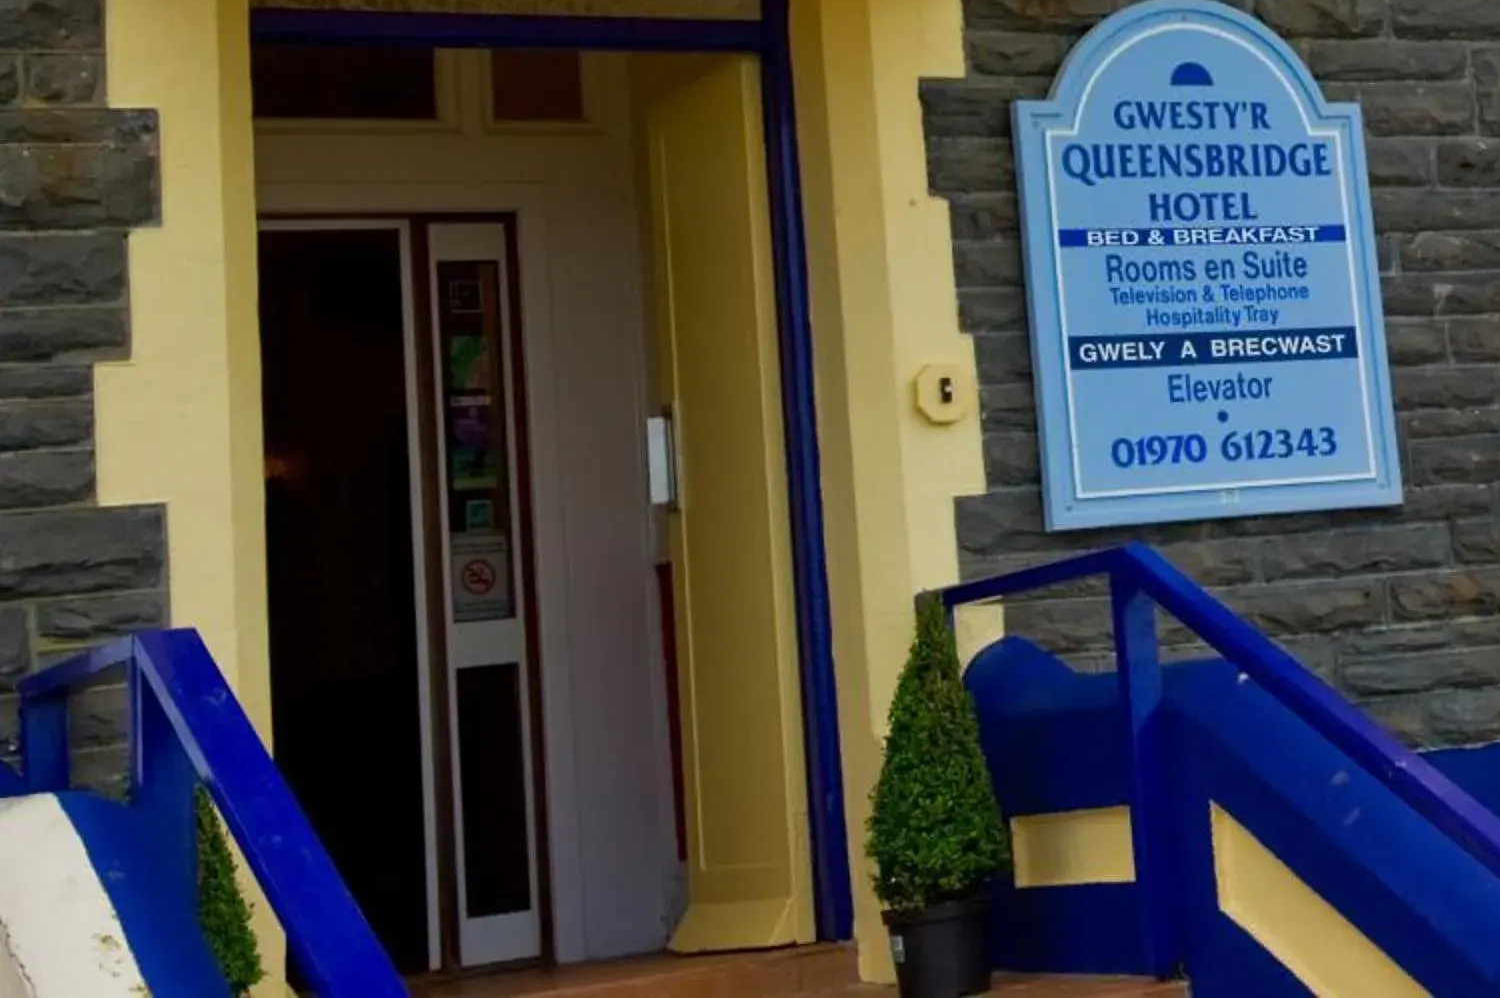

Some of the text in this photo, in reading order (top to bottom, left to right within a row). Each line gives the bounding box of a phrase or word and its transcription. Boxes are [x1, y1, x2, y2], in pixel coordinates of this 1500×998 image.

[1113, 101, 1271, 131] GWESTY'R
[1061, 143, 1332, 186] QUEENSBRIDGE
[1149, 193, 1257, 222] HOTEL
[1087, 227, 1319, 246] BED & BREAKFAST
[1106, 251, 1308, 283] Rooms en Suite
[1110, 284, 1310, 306] Television & Telephone
[1146, 305, 1279, 328] Hospitality Tray
[1079, 335, 1346, 362] GWELY A BRECWAST
[1168, 372, 1272, 403] Elevator
[1111, 427, 1337, 468] 01970 612343
